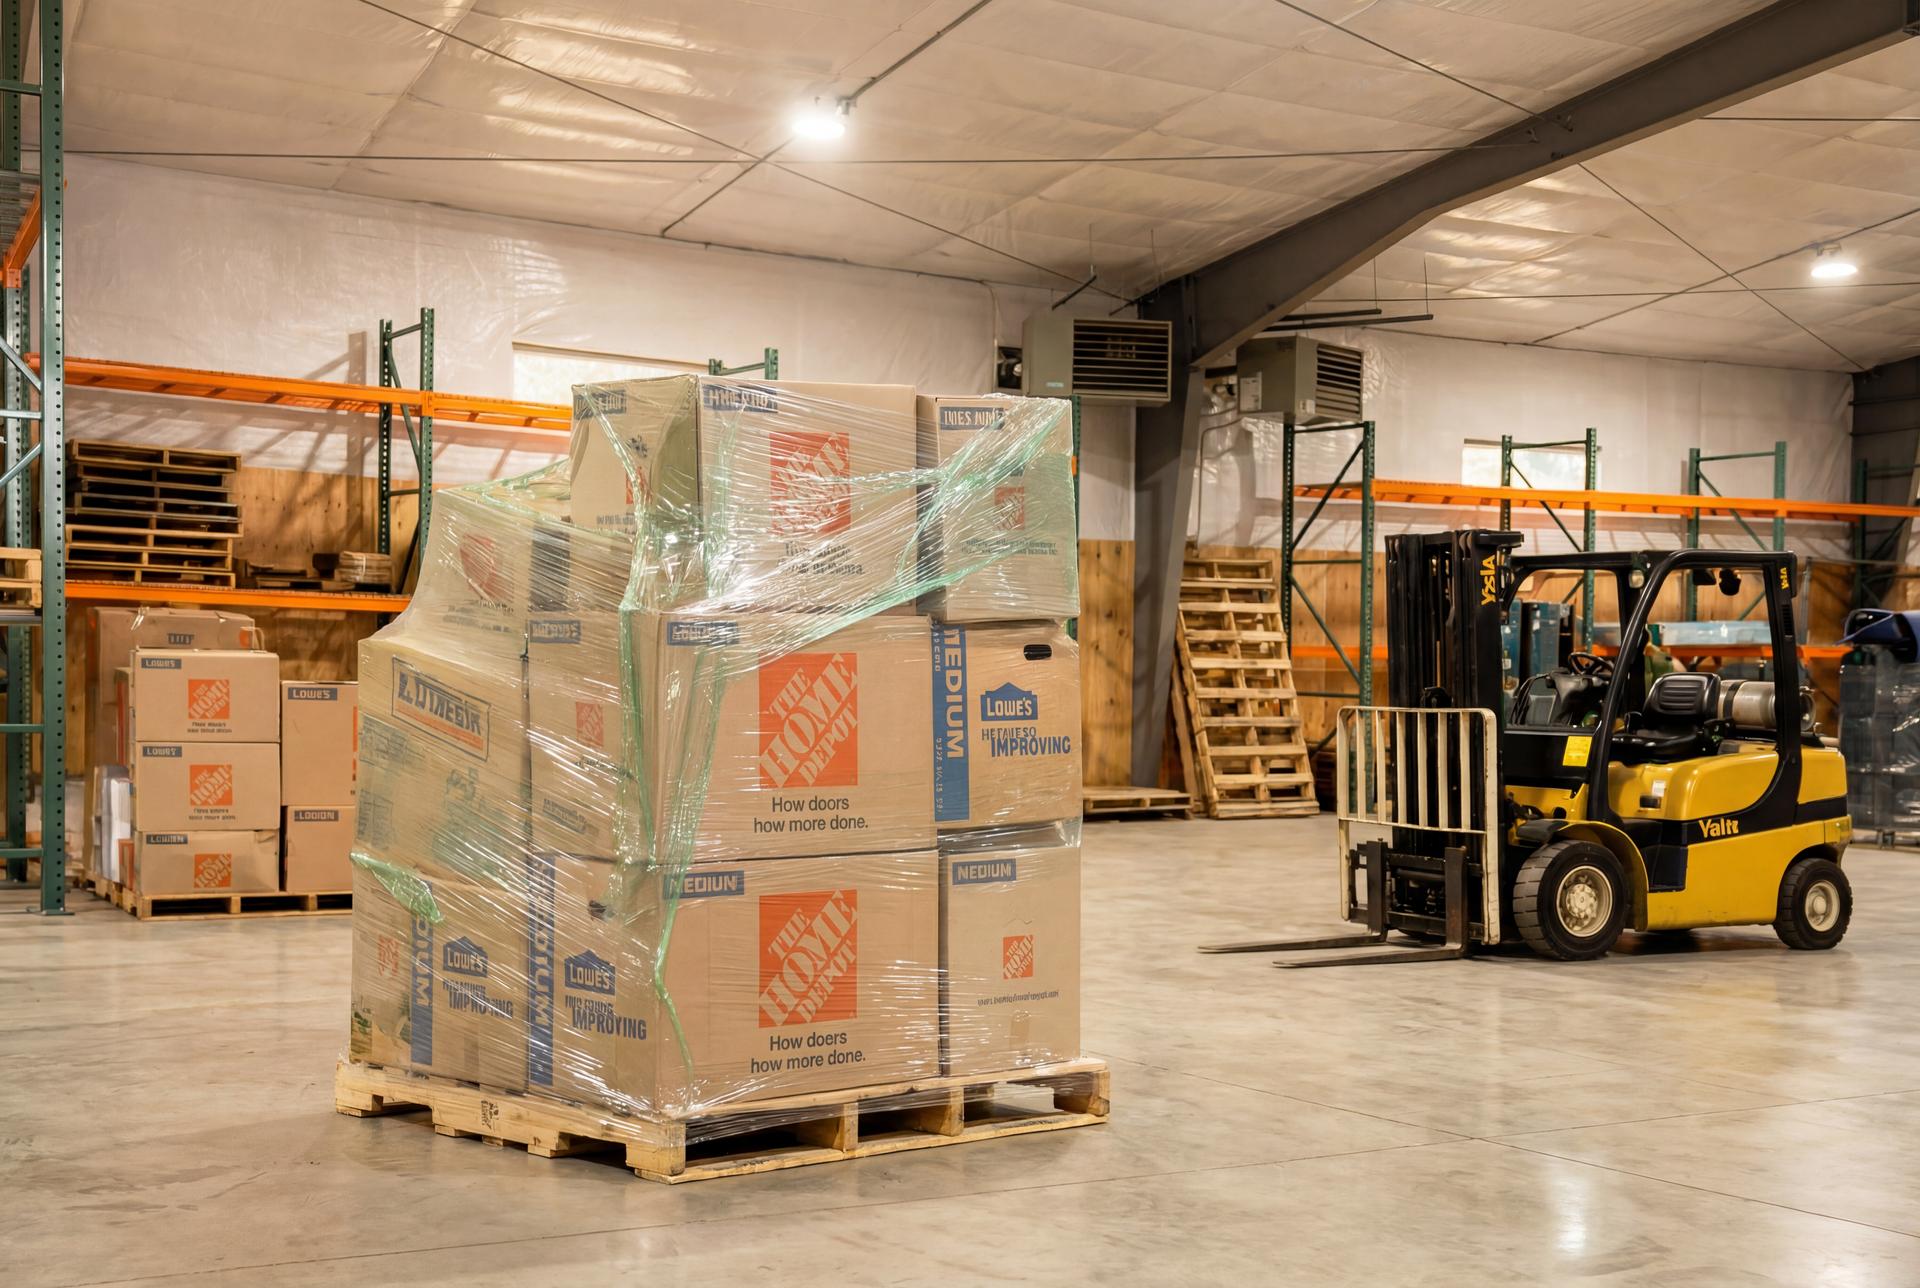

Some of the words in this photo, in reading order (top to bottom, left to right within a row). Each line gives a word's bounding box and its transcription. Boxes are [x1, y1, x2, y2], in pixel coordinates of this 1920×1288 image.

[769, 667, 813, 721] THE
[759, 652, 858, 789] HOME
[797, 701, 859, 788] DEPOT
[991, 735, 1071, 758] IMPROVING
[772, 796, 806, 813] How
[808, 795, 850, 812] doors
[753, 817, 787, 834] how
[789, 818, 827, 832] more
[829, 814, 869, 830] done.
[767, 907, 812, 961] THE
[759, 889, 858, 1027] HOME
[769, 1034, 804, 1051] How
[806, 1031, 848, 1048] doers
[750, 1057, 784, 1074] how
[786, 1055, 825, 1070] more
[827, 1049, 867, 1066] done.
